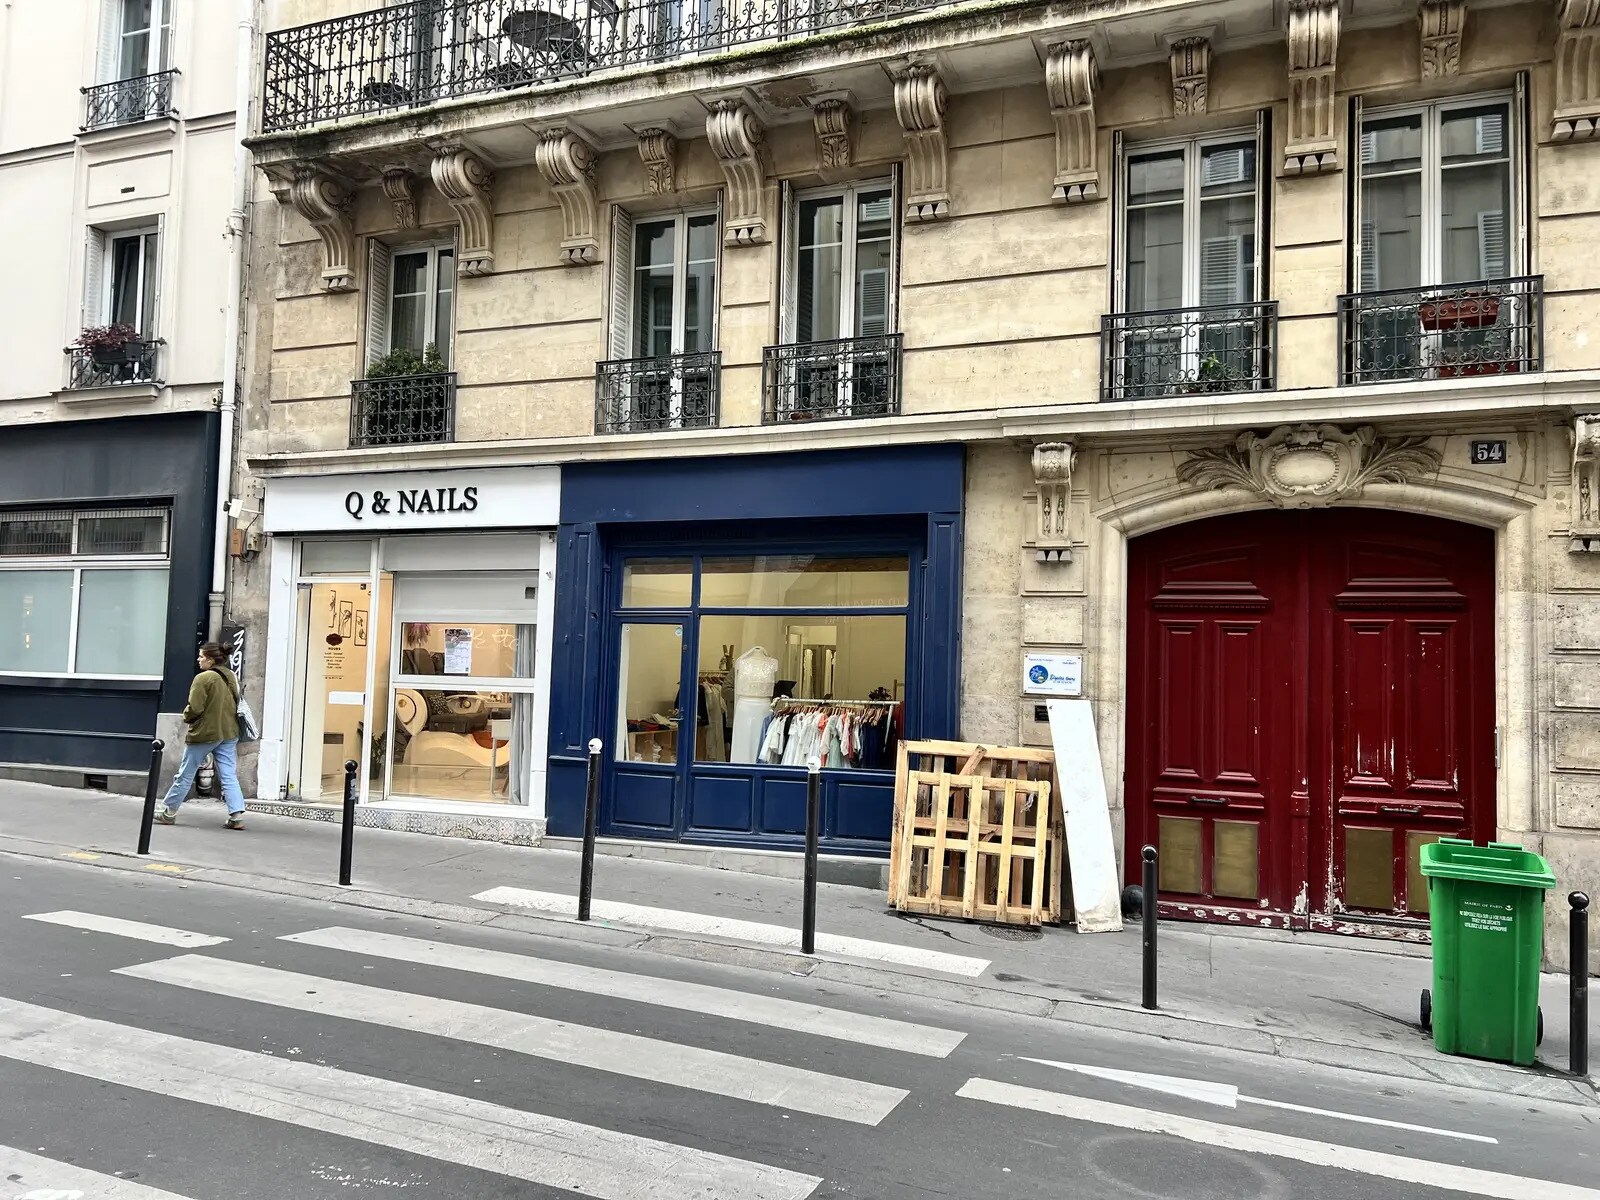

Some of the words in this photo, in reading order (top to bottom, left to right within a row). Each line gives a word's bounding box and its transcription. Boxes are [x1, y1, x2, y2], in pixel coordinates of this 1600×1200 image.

[1477, 443, 1502, 461] 54
[345, 491, 364, 520] Q
[371, 490, 391, 514] &
[397, 486, 478, 513] NAILS
